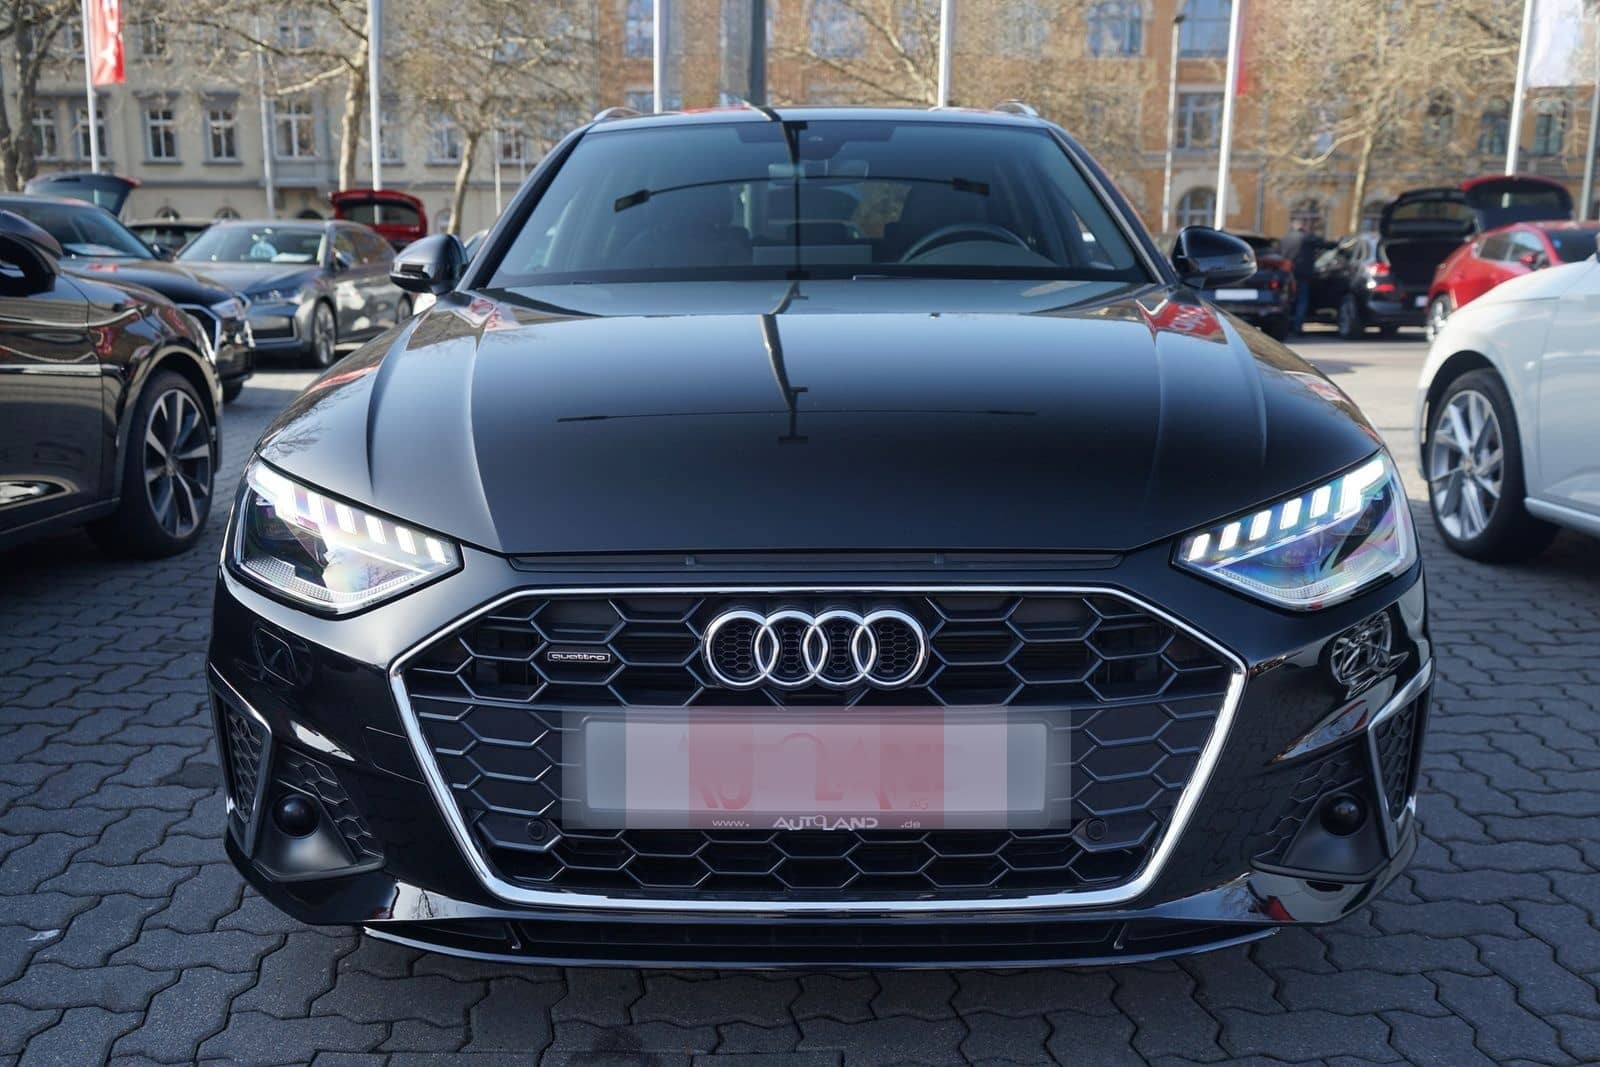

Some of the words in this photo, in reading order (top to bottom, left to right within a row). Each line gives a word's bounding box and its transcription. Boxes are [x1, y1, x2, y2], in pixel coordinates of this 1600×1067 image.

[551, 653, 606, 661] quattro
[712, 819, 750, 827] www.
[771, 814, 879, 831] AUTOLAND
[901, 820, 921, 828] .de
